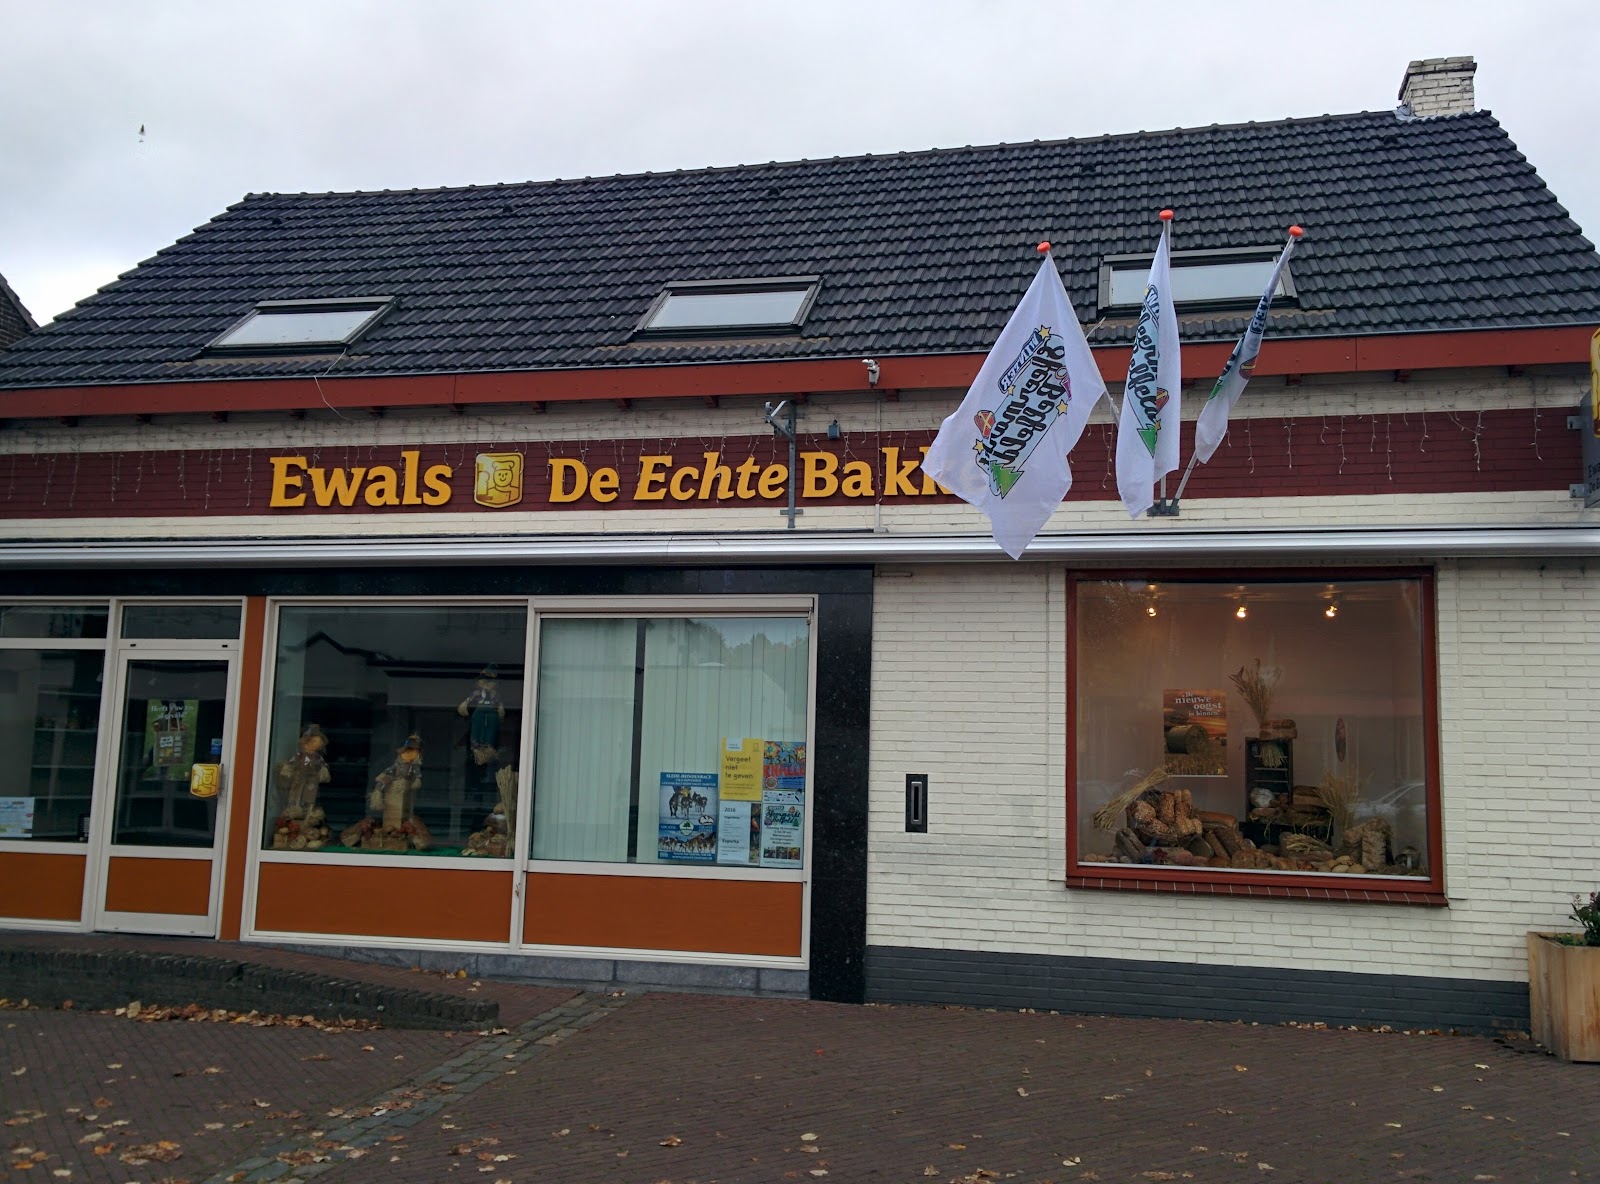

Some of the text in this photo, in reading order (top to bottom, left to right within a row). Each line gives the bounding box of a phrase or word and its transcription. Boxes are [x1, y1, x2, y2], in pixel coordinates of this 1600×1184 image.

[269, 446, 956, 507] Ewals De Echte Bakk
[1175, 694, 1212, 704] nieuwe
[1193, 702, 1222, 711] oogst
